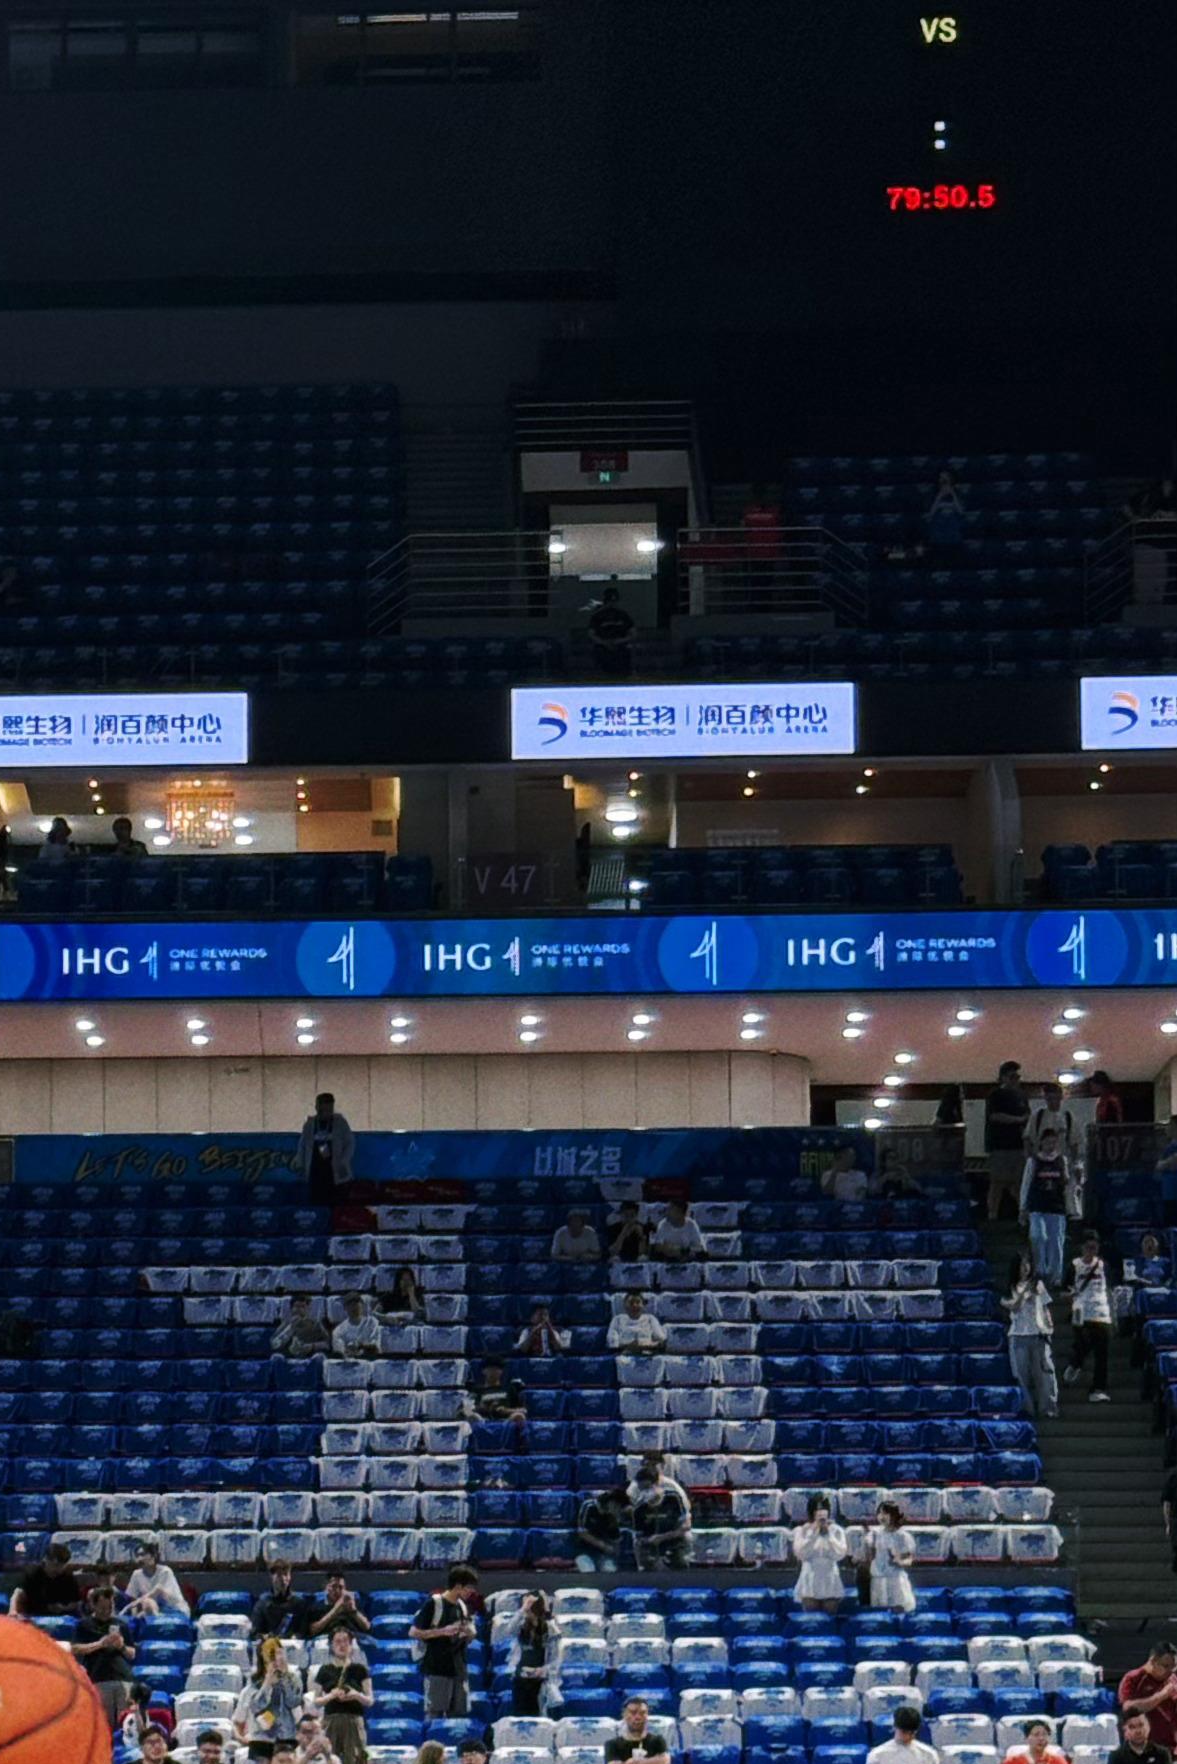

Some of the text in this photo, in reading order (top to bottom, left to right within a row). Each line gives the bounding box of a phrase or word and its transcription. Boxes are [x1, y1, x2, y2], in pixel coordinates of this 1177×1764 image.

[920, 17, 957, 43] VS
[886, 185, 995, 211] 79:50.5
[94, 713, 222, 736] 润百颜中心
[580, 703, 827, 726] 华熙生物 润百颜中心
[500, 865, 536, 895] 47
[62, 947, 268, 975] IHG ONE REWARDS
[424, 943, 631, 971] IHG ONE REWARDS
[787, 937, 996, 966] IHG ONE REWARDS
[535, 1146, 622, 1177] 以城之名
